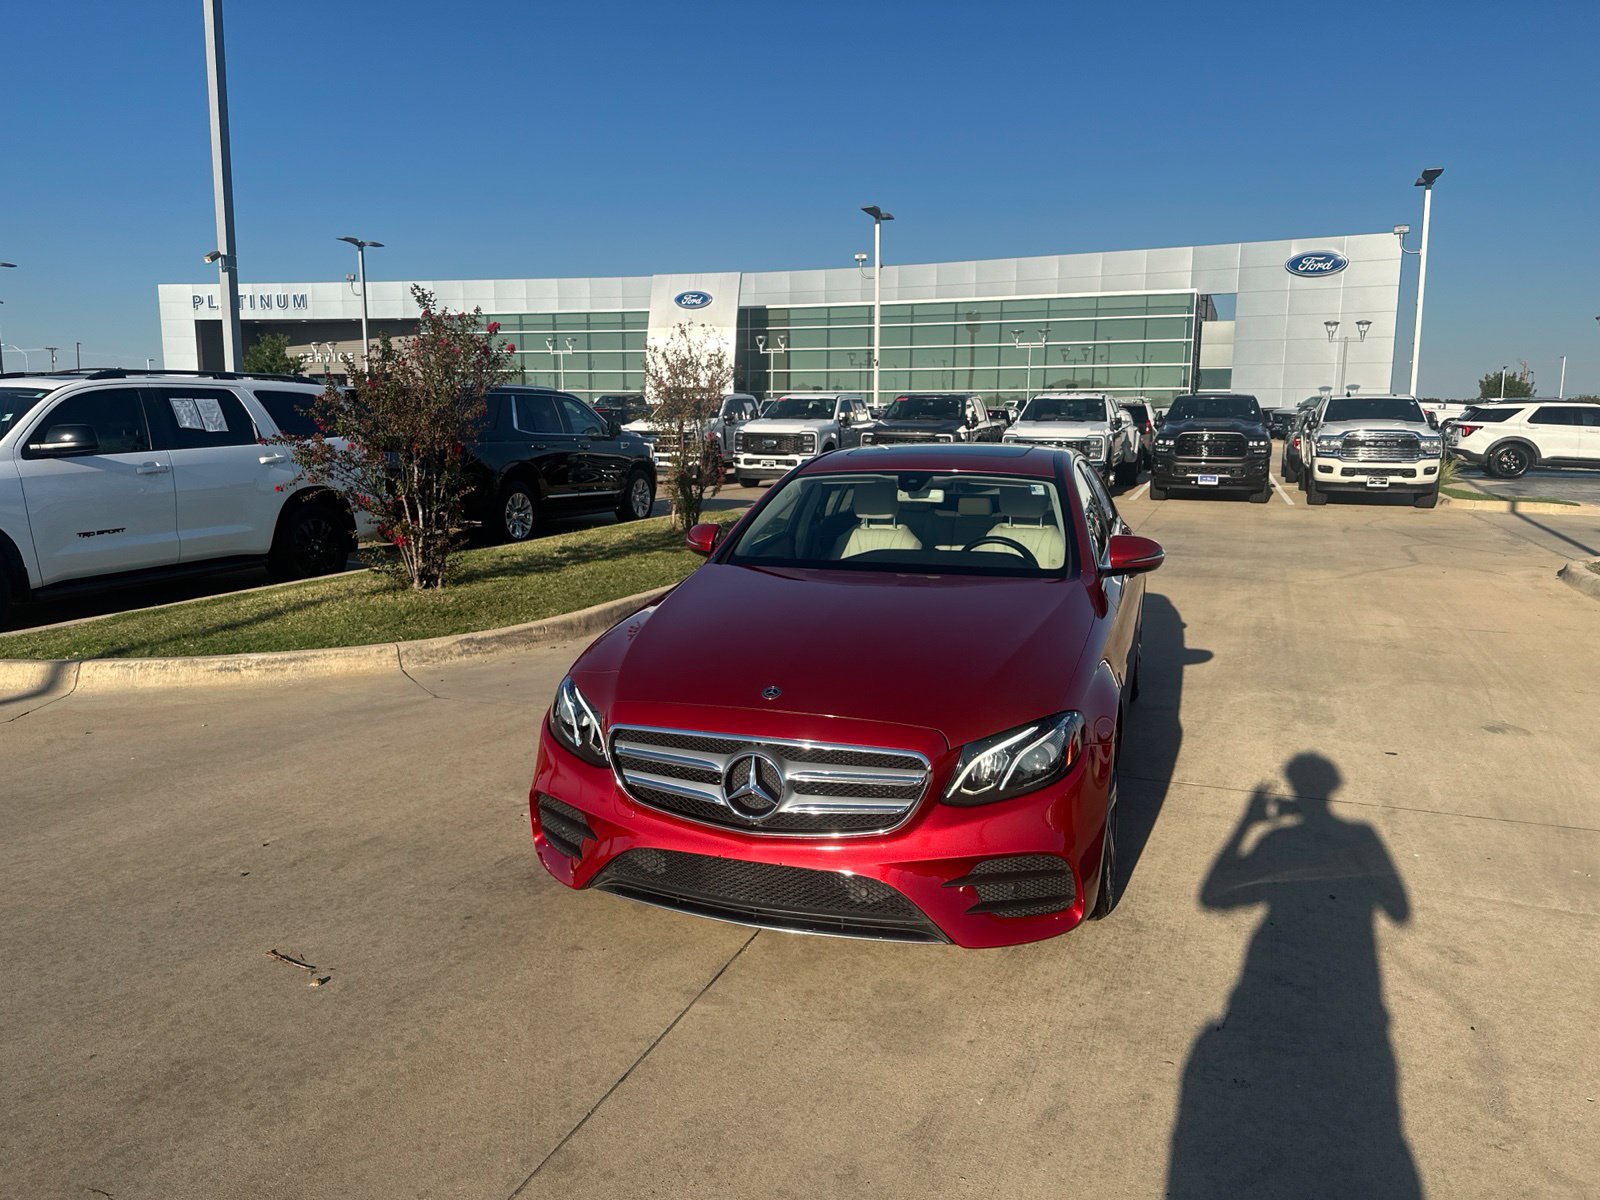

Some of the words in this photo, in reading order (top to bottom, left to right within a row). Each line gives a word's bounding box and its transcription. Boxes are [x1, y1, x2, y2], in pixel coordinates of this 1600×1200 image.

[1298, 256, 1334, 271] Ford
[192, 294, 307, 310] PLTINUM
[681, 294, 703, 305] Ford
[96, 528, 126, 536] SPORT
